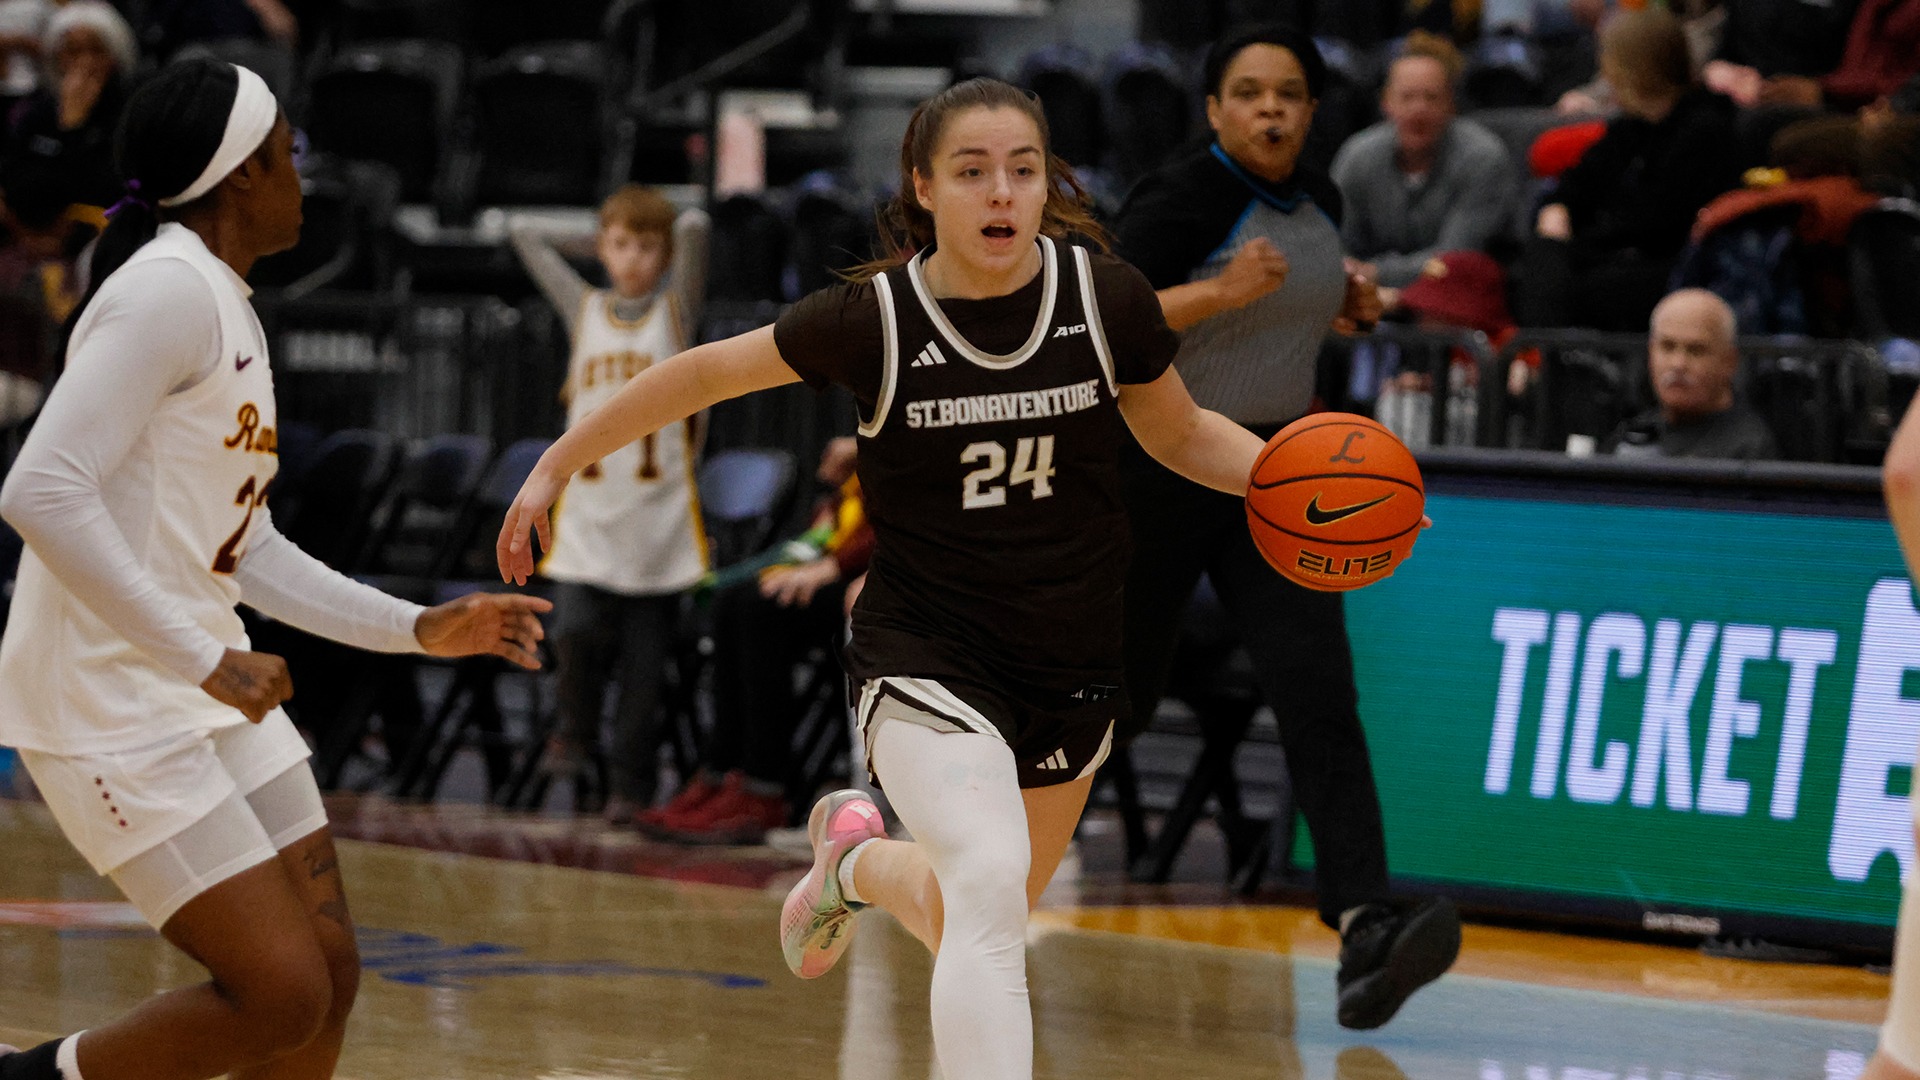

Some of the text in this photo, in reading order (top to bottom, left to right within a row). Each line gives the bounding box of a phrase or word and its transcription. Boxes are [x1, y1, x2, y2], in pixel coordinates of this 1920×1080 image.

[1052, 323, 1087, 338] A10
[905, 378, 1100, 428] ST.BONAVENTURE
[960, 434, 1056, 510] 24
[1484, 606, 1838, 820] TICKET
